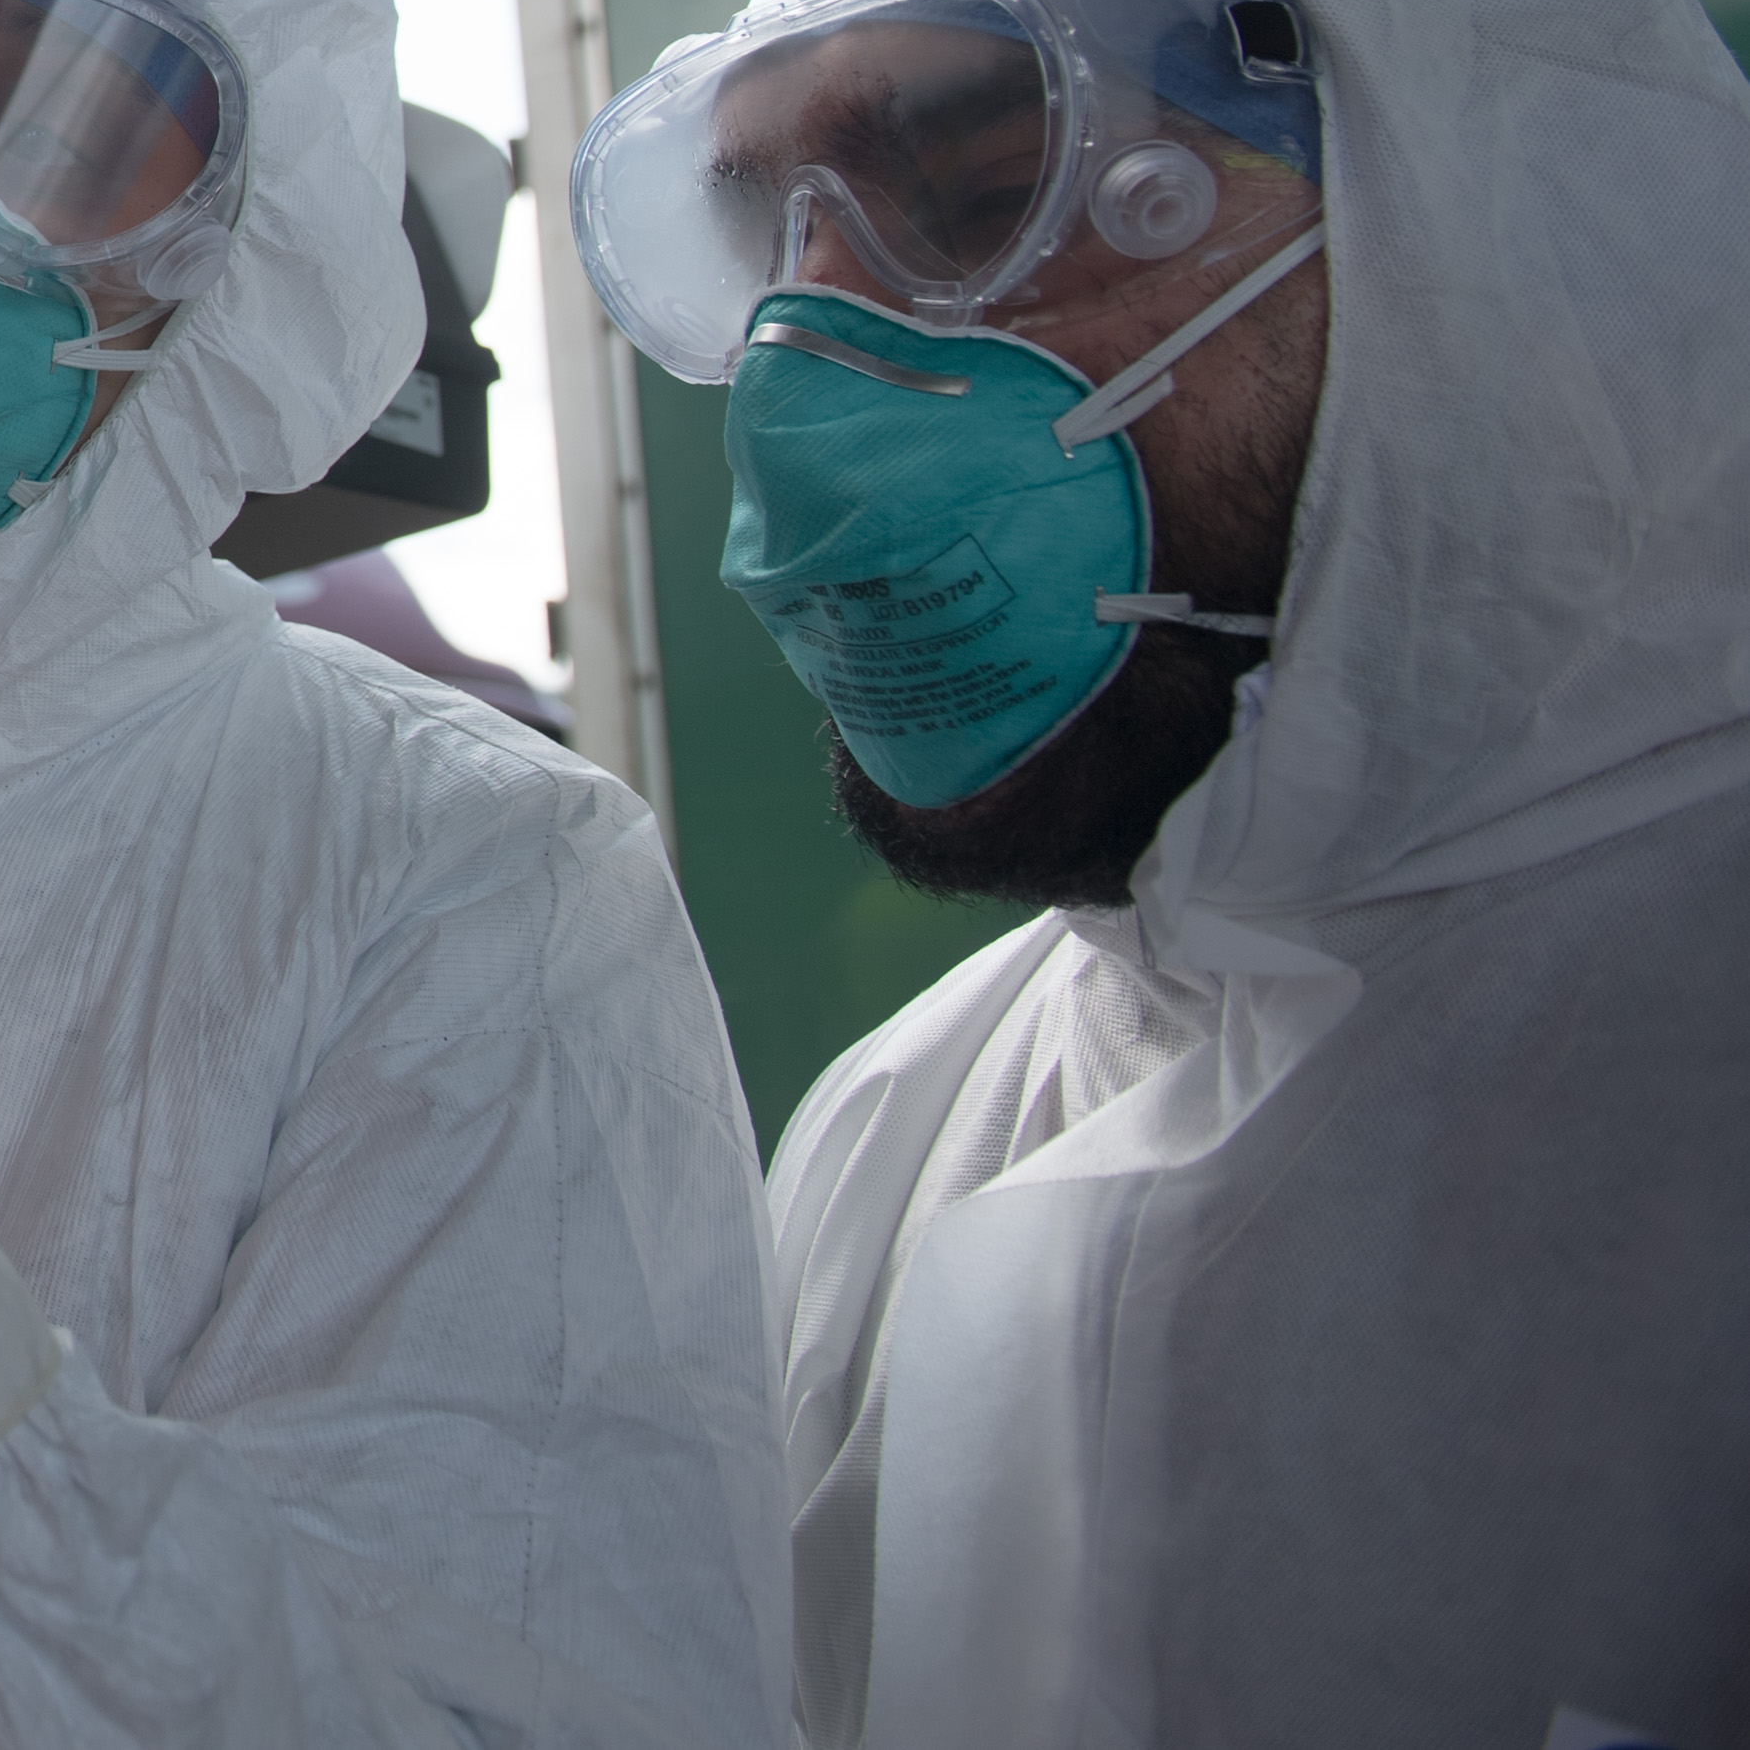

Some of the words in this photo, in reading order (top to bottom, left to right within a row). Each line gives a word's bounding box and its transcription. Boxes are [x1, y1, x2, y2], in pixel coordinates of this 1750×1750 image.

[869, 604, 901, 620] LOT
[902, 569, 986, 617] B19794
[906, 612, 1010, 658] RESPIRATOR
[900, 659, 947, 676] MASK
